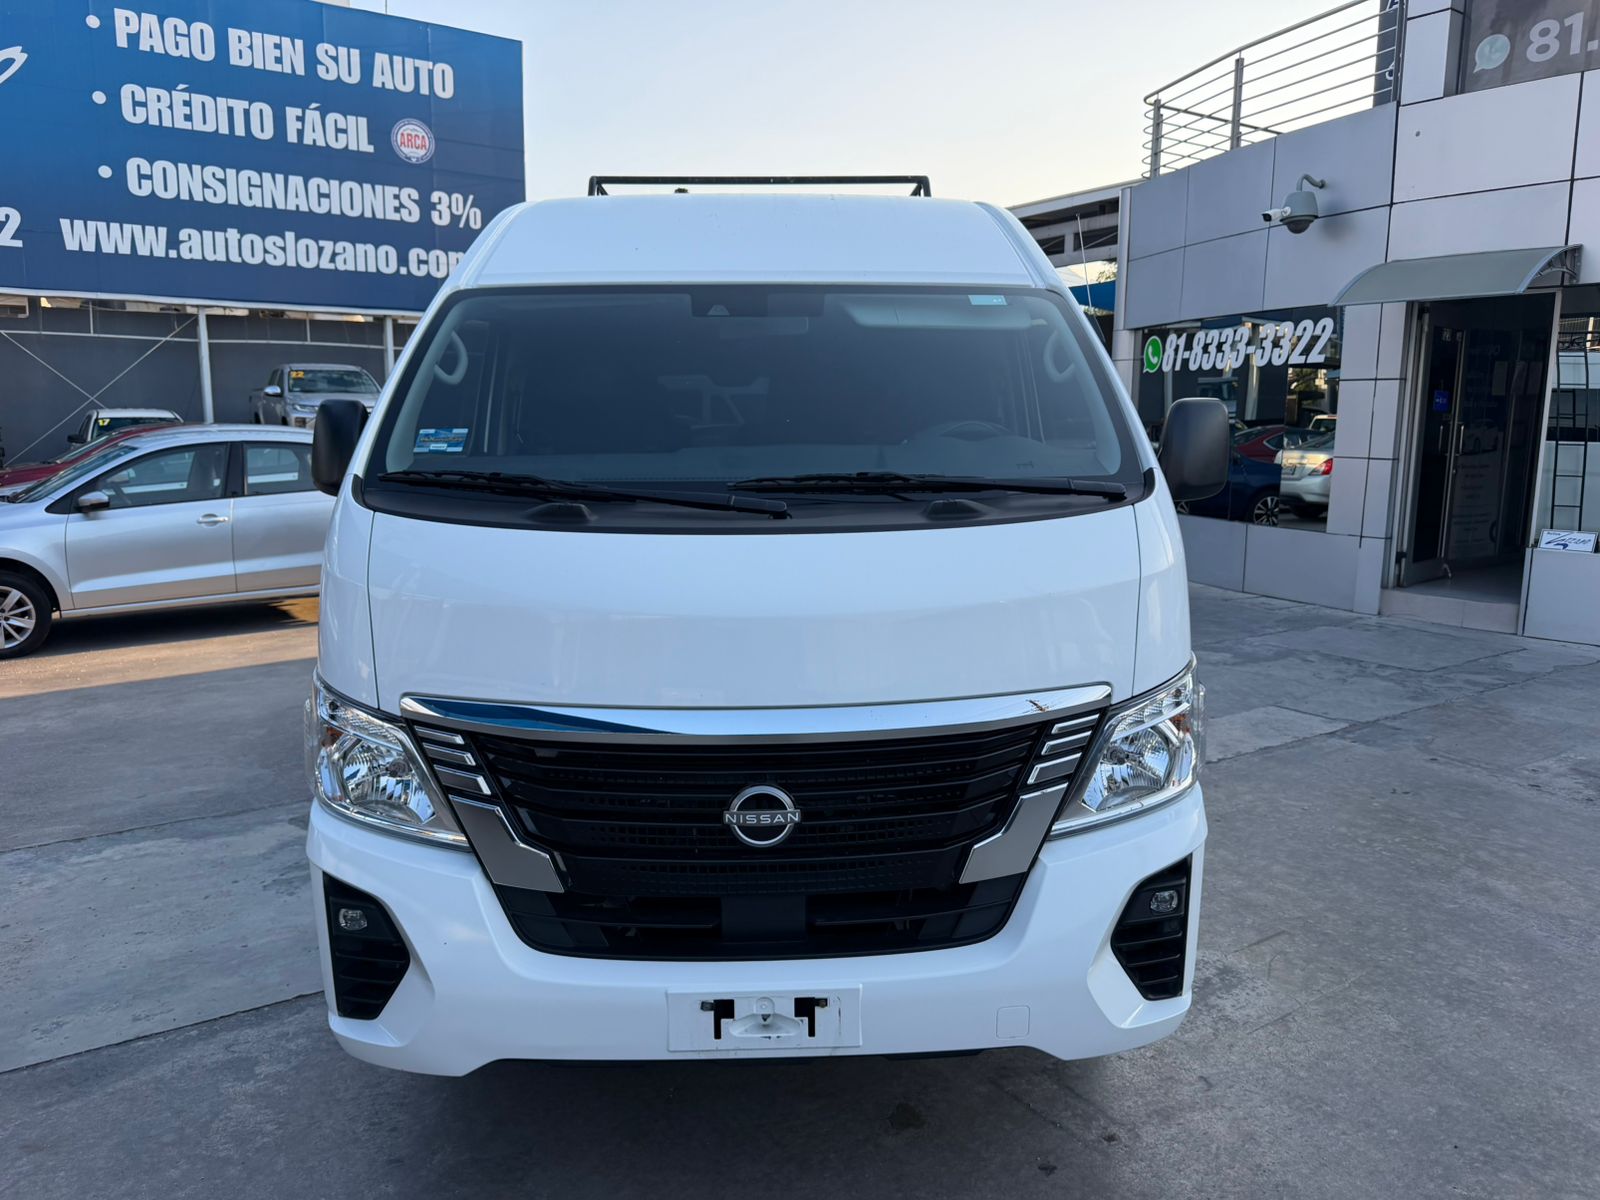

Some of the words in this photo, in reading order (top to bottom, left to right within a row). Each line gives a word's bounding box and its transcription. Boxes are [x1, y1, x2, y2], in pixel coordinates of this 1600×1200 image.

[113, 7, 216, 62] PAGO
[227, 27, 305, 76] BIEN
[315, 42, 361, 85] SU
[372, 52, 455, 100] AUTO
[120, 83, 275, 140] CRÉDITO
[285, 102, 375, 153] FÁCIL
[399, 132, 428, 150] ARCA
[126, 156, 421, 223] CONSIGNACIONES
[430, 190, 482, 230] 3%
[1161, 317, 1335, 373] 81-8333-3322
[725, 811, 799, 824] NISSAN
